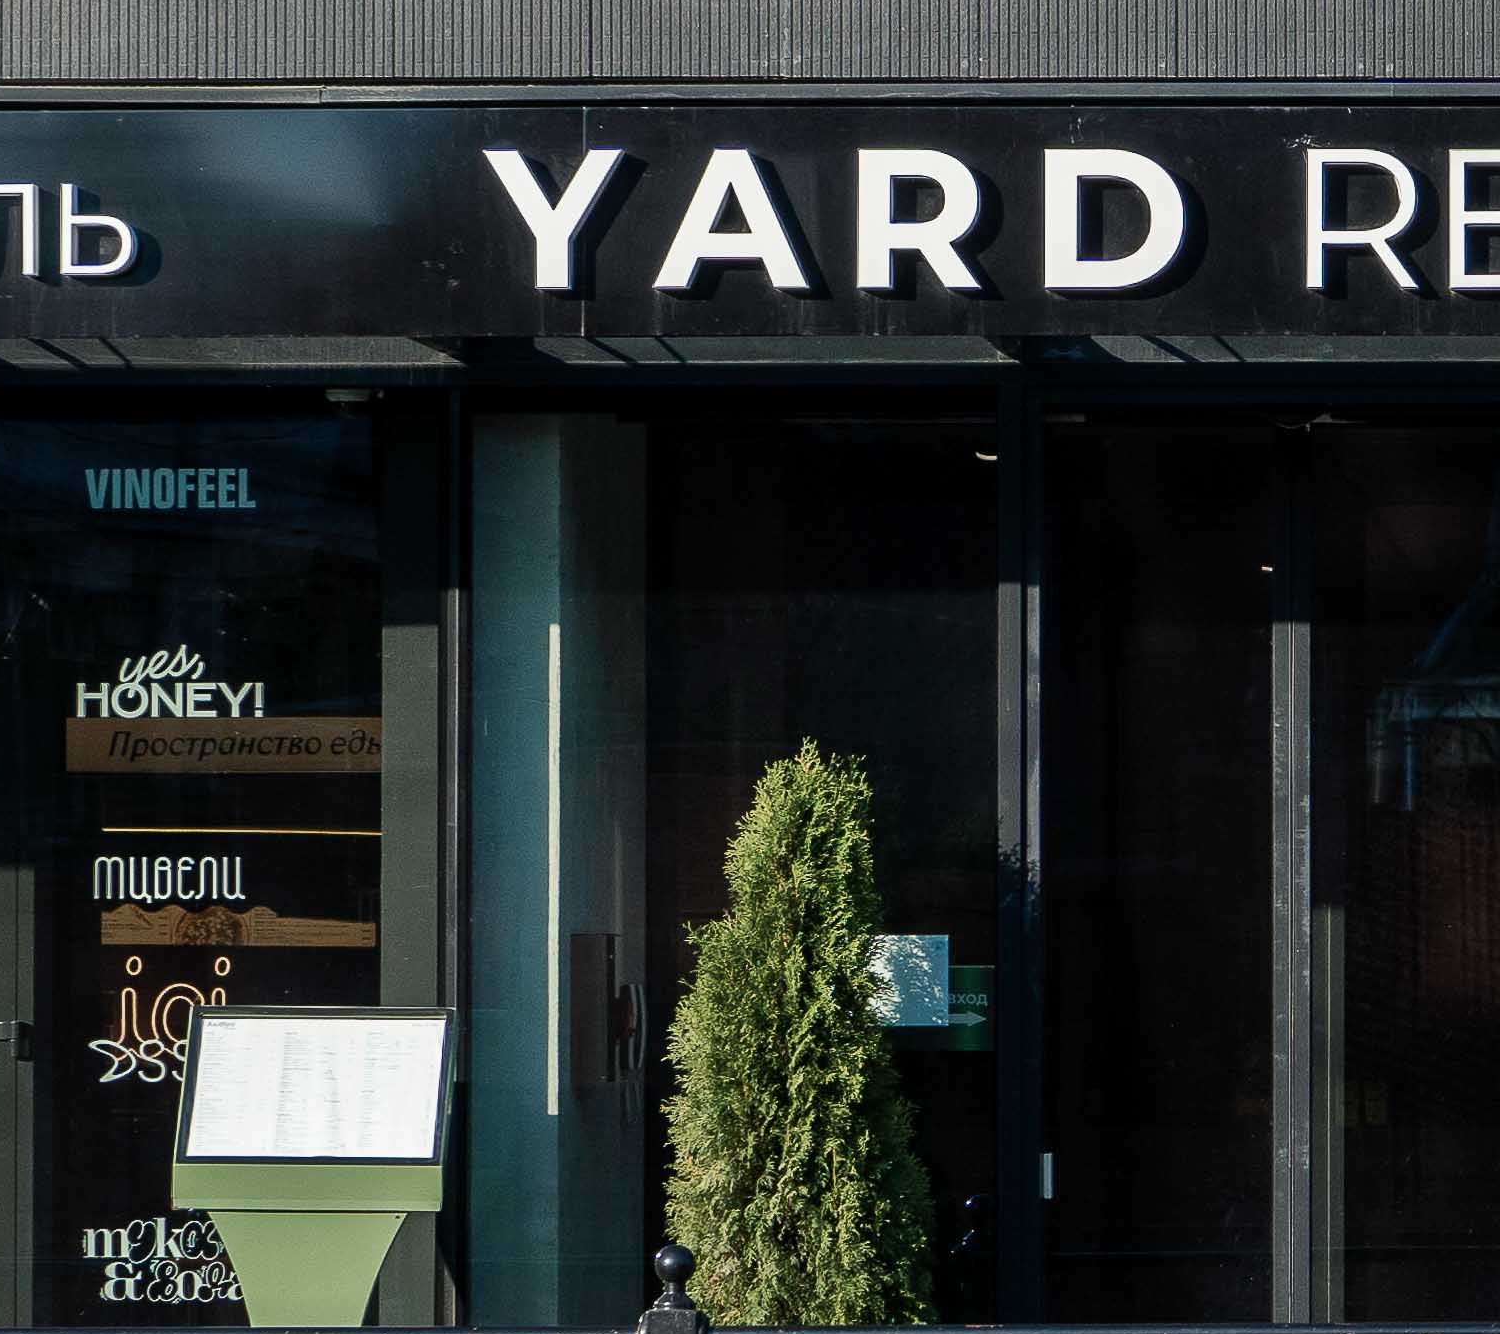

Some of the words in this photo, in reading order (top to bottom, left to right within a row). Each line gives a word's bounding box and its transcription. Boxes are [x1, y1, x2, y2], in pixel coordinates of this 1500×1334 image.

[482, 148, 1187, 290] YARD
[85, 467, 257, 510] VINOFEEL
[75, 682, 265, 719] HONEY!
[108, 730, 323, 762] Пространство
